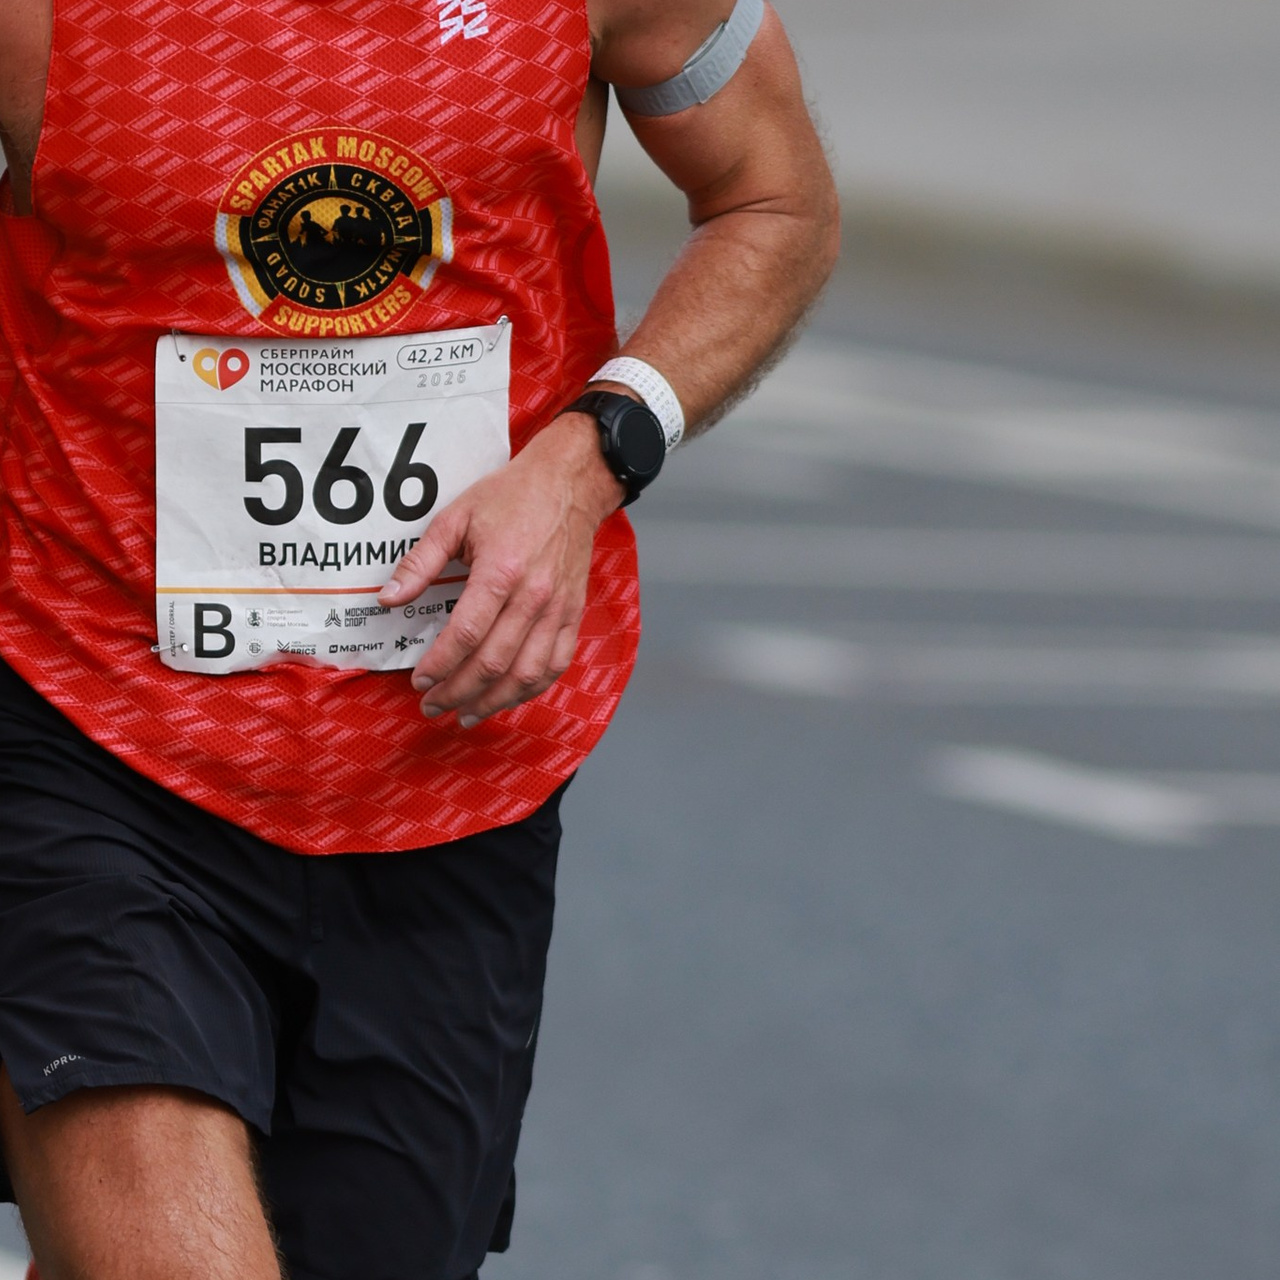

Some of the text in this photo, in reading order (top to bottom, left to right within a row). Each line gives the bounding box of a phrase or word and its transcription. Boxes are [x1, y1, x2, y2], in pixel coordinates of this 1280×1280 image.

[229, 135, 438, 211] SPARTAK MOSCOW
[350, 172, 414, 230] СКВАД
[266, 252, 325, 303] SQUAD
[272, 284, 413, 337] SUPPORTERS
[260, 347, 354, 359] СБЕРПРАЙМ
[407, 343, 474, 364] 42,2 КМ
[260, 359, 387, 376] МОСКОВСКИЙ
[260, 378, 354, 393] МАРАФОН
[417, 370, 467, 388] 2026
[243, 422, 439, 526] 566
[418, 604, 443, 615] СБЕР
[194, 602, 236, 659] B
[344, 617, 367, 627] СПОРТ
[339, 641, 384, 652] магнит
[43, 1054, 86, 1077] KIPRU
